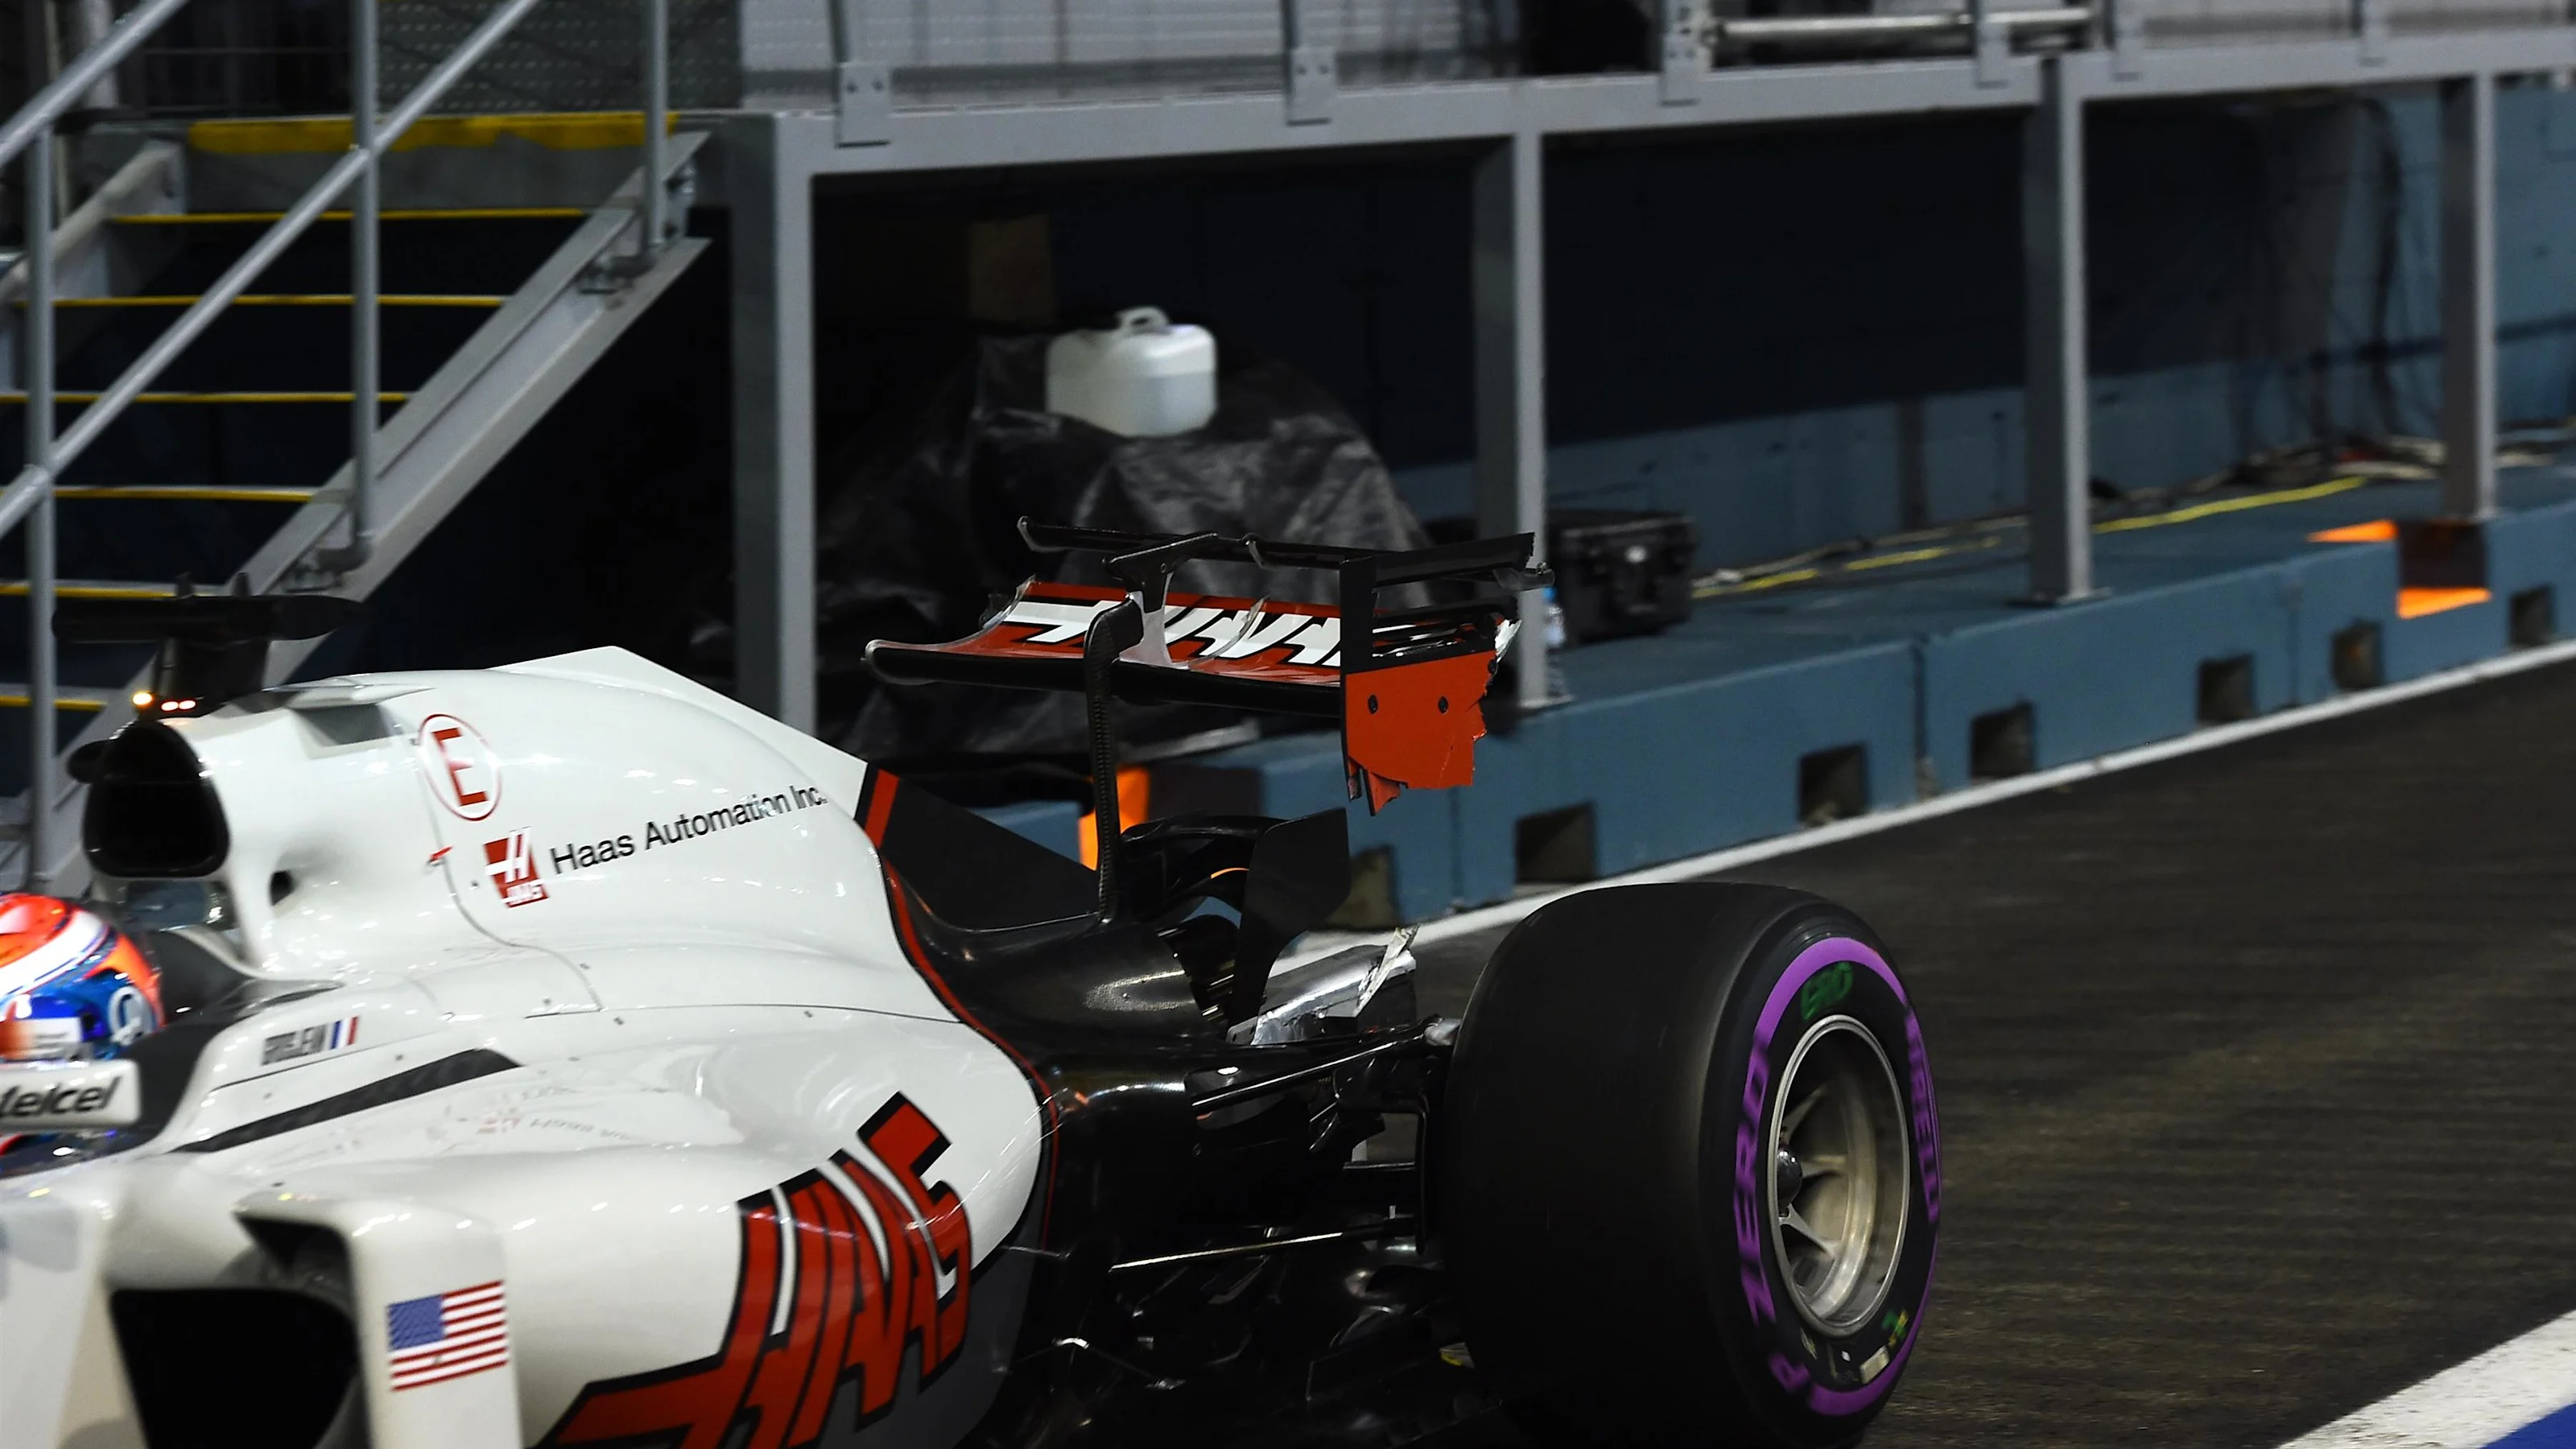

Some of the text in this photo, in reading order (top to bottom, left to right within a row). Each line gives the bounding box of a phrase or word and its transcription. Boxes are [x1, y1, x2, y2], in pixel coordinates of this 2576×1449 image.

[1004, 599, 1341, 667] HAA
[431, 727, 489, 807] E
[550, 785, 828, 875] Haas Automation Inc.
[1734, 1044, 1777, 1327] ZERO
[527, 1092, 973, 1449] HAAS
